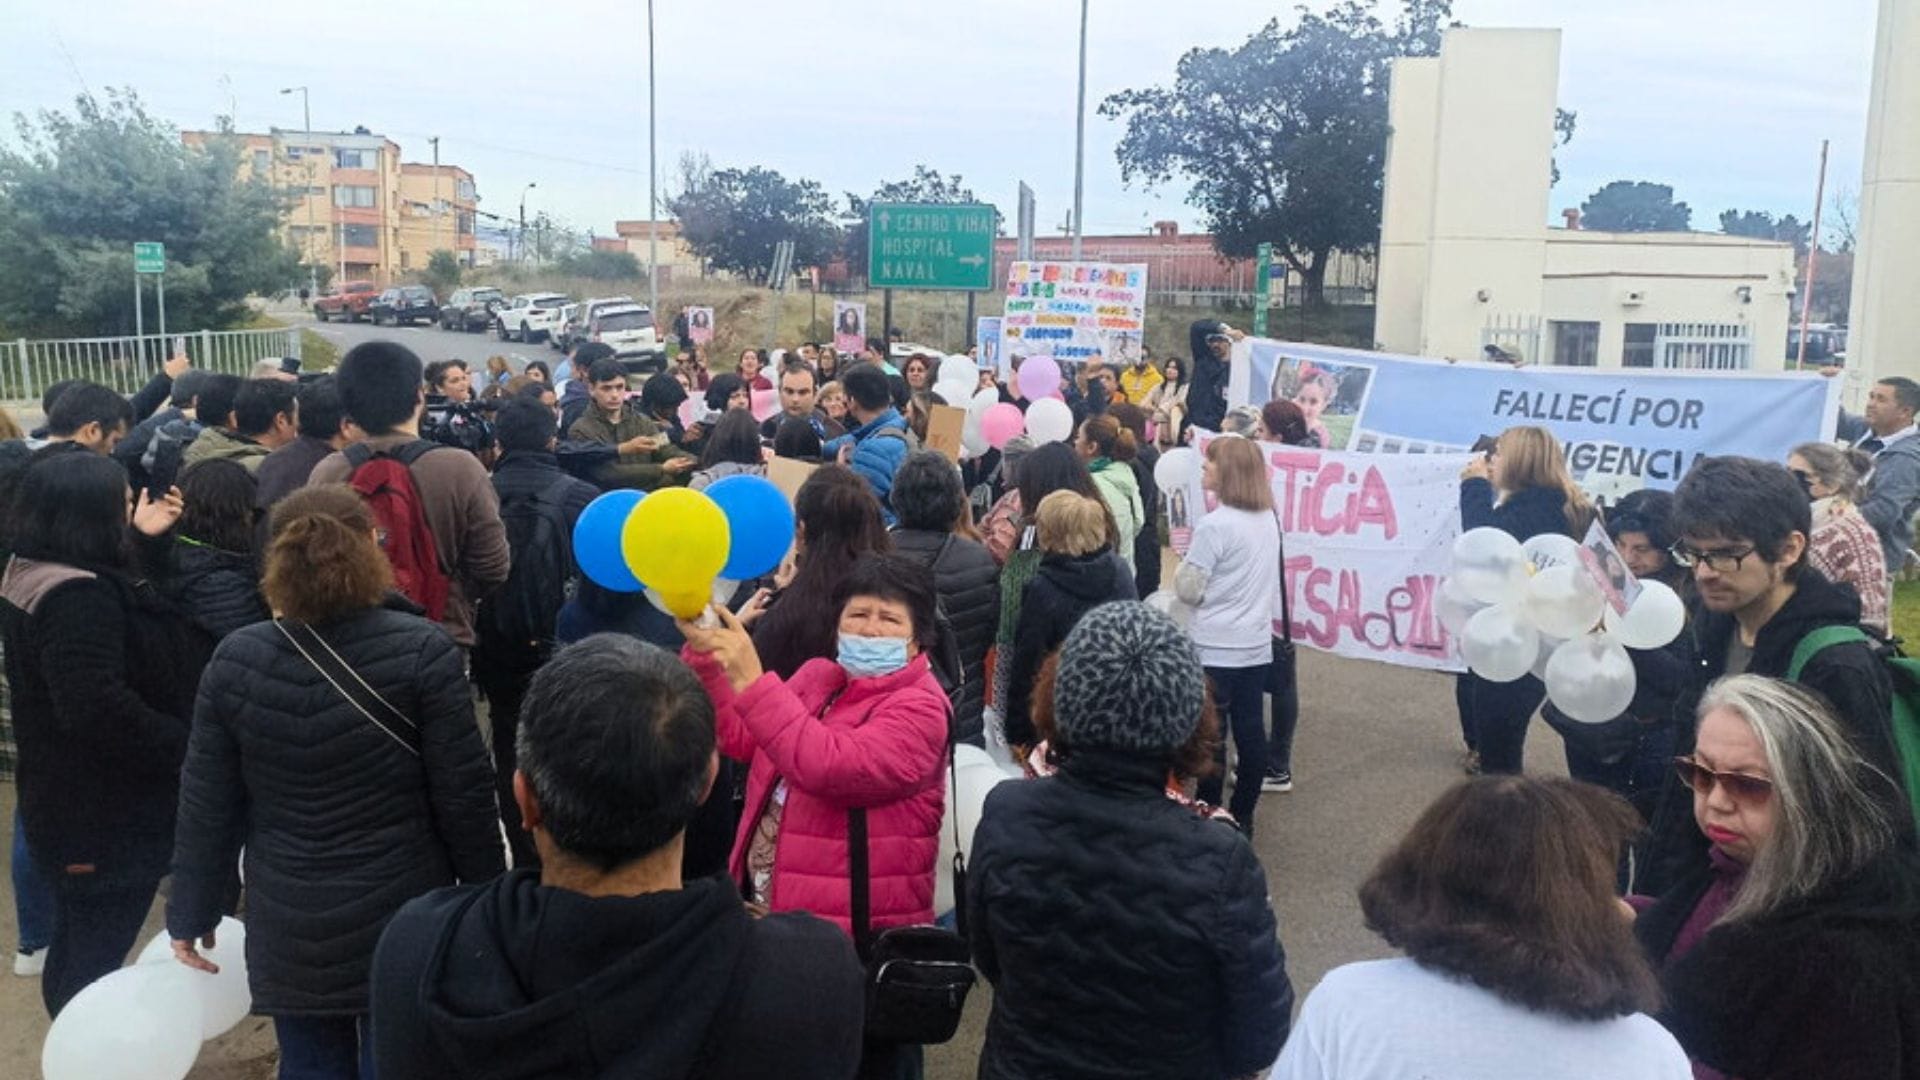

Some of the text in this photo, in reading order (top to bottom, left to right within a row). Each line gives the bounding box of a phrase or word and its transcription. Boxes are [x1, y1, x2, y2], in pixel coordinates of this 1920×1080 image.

[897, 214, 949, 232] CENTRO
[882, 237, 954, 257] HOSPITAL
[882, 261, 936, 279] NAVAL
[1493, 388, 1704, 430] FALLECÍ POR
